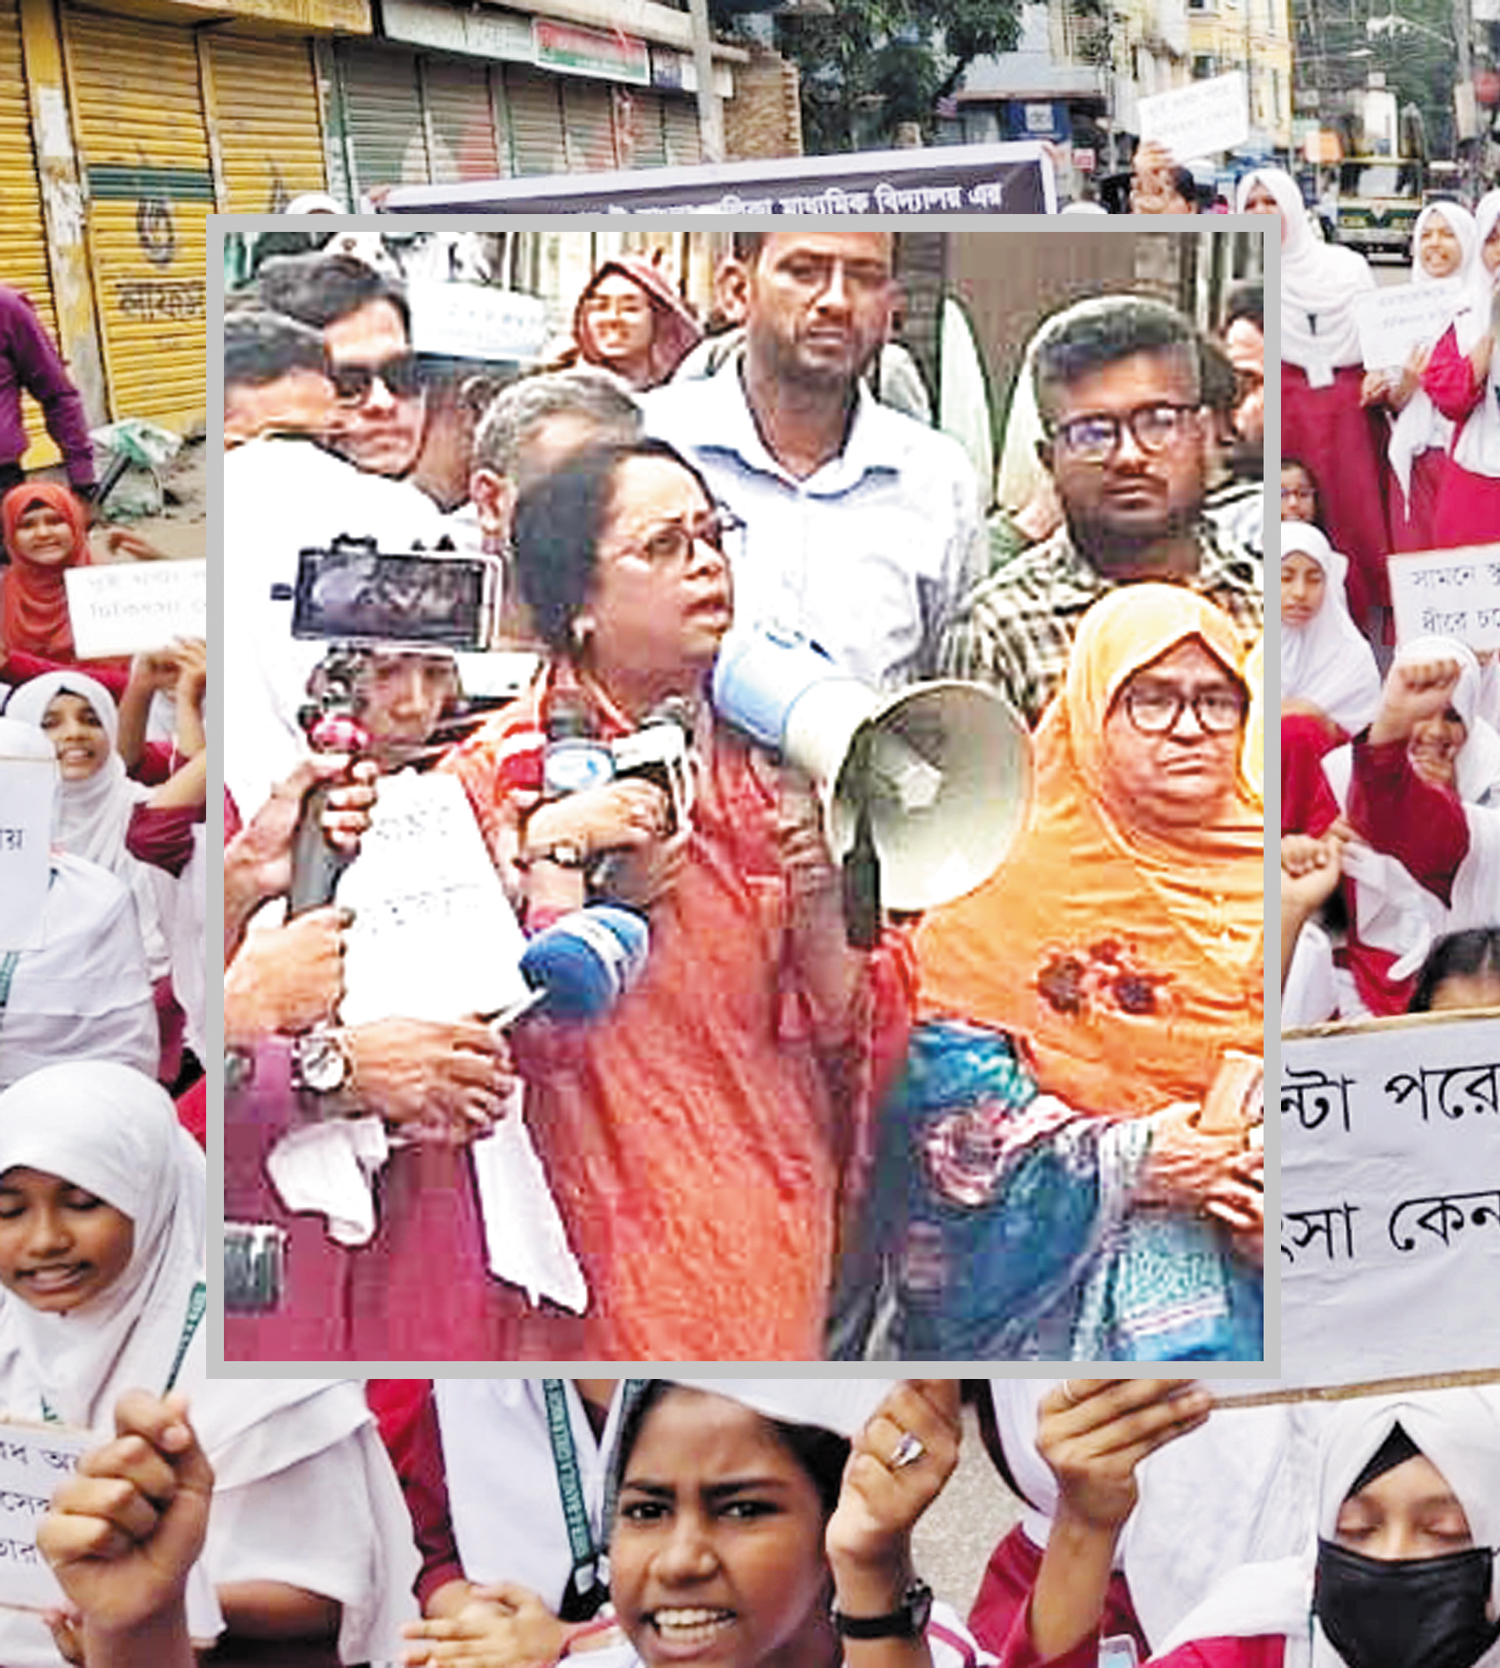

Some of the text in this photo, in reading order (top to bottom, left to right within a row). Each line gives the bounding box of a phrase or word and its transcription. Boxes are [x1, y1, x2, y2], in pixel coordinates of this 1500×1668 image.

[1411, 565, 1476, 588] সামনে
[1422, 606, 1467, 634] ধীরে
[1281, 1064, 1358, 1133] ন্টা
